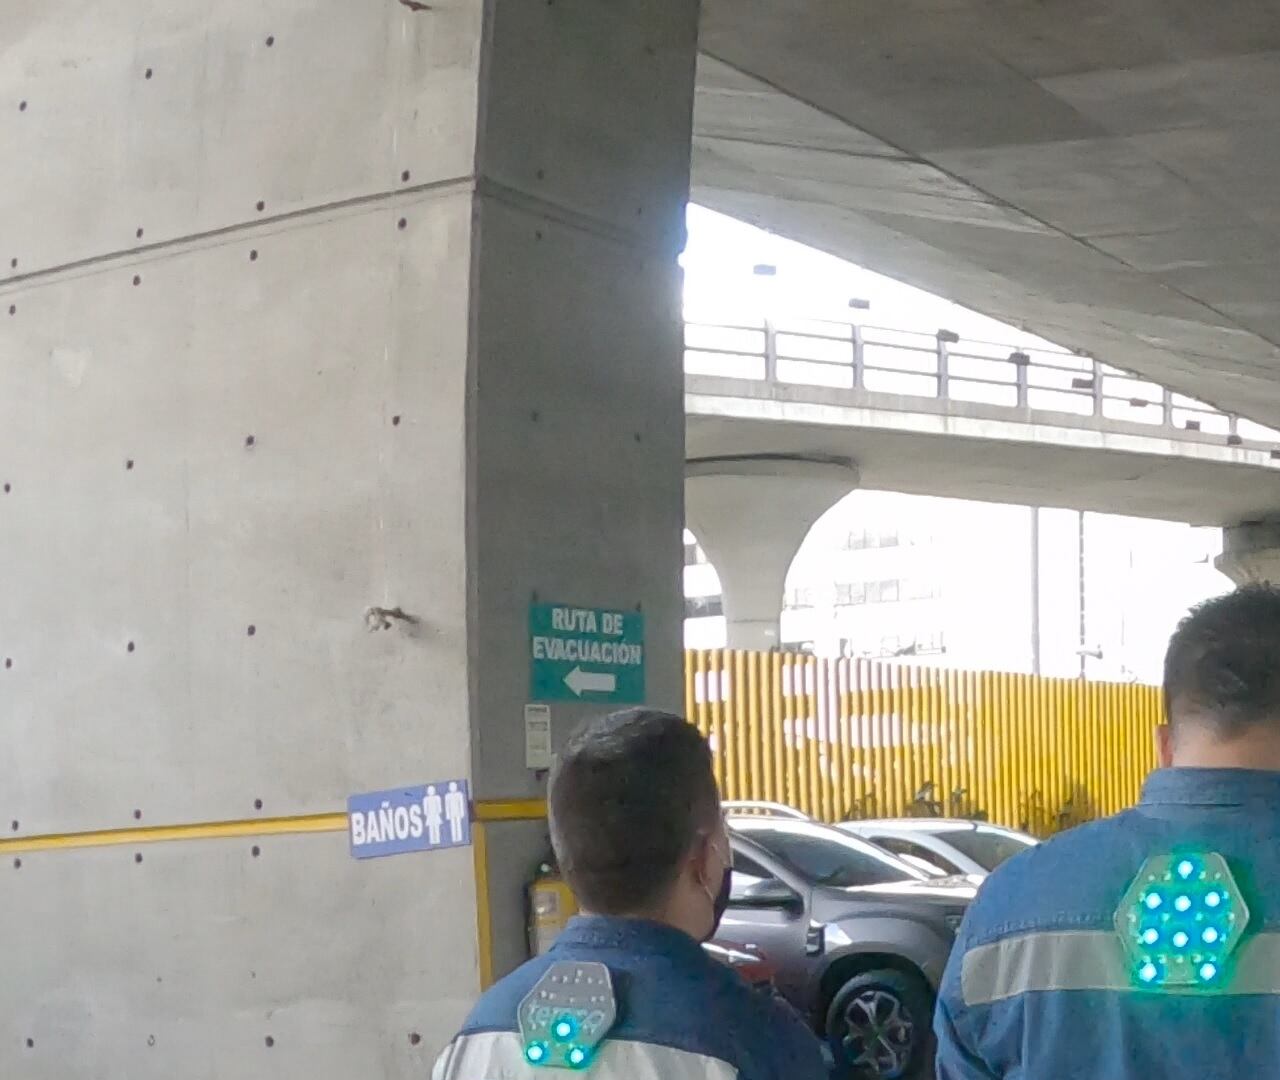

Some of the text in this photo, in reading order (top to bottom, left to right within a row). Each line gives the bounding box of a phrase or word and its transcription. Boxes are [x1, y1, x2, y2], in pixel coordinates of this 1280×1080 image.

[552, 607, 624, 636] RUTA DE
[532, 636, 642, 665] EVACUACIÓN
[351, 801, 424, 846] BAÑOS
